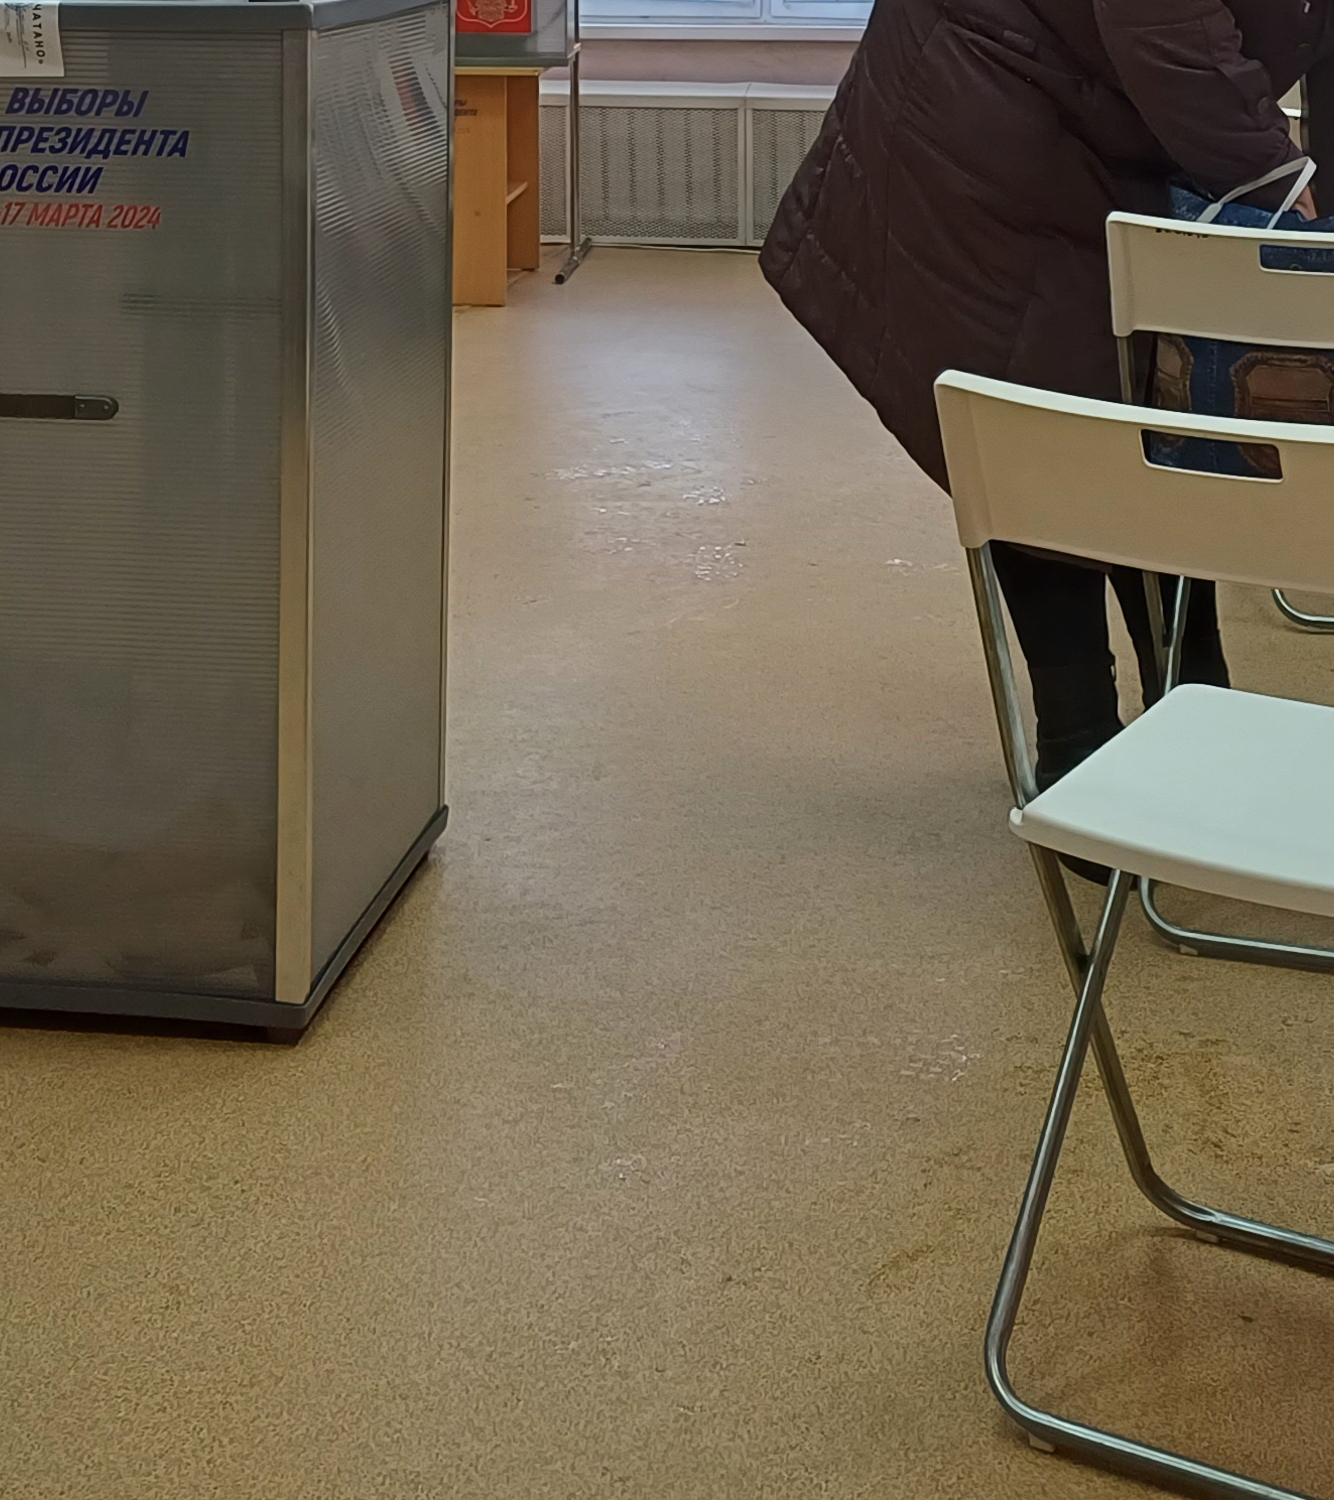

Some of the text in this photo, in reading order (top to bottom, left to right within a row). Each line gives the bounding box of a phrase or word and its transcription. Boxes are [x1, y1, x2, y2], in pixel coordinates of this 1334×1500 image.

[5, 87, 149, 118] ВЫБОРЫ
[26, 202, 103, 228] МАРТА
[107, 204, 162, 230] 2024
